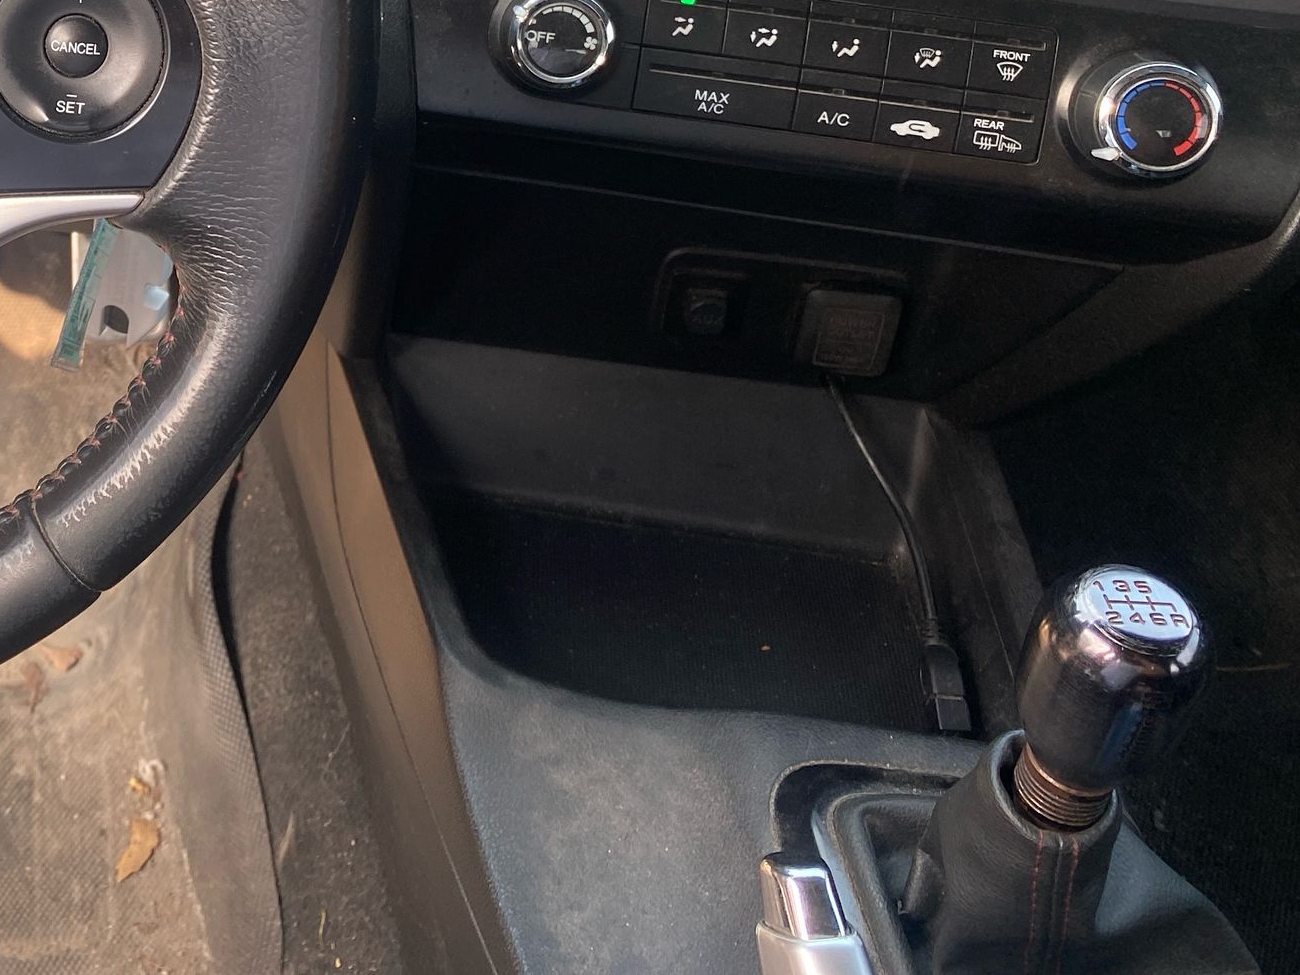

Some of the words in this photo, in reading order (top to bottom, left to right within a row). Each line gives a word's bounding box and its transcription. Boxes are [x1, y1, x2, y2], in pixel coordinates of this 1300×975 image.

[526, 29, 556, 45] OFF
[50, 40, 101, 56] CANCEL
[993, 49, 1032, 62] FRONT
[694, 90, 730, 105] MAX
[56, 100, 86, 115] SET
[697, 101, 725, 115] A/C
[817, 111, 851, 127] A/C
[973, 118, 1005, 131] REAR
